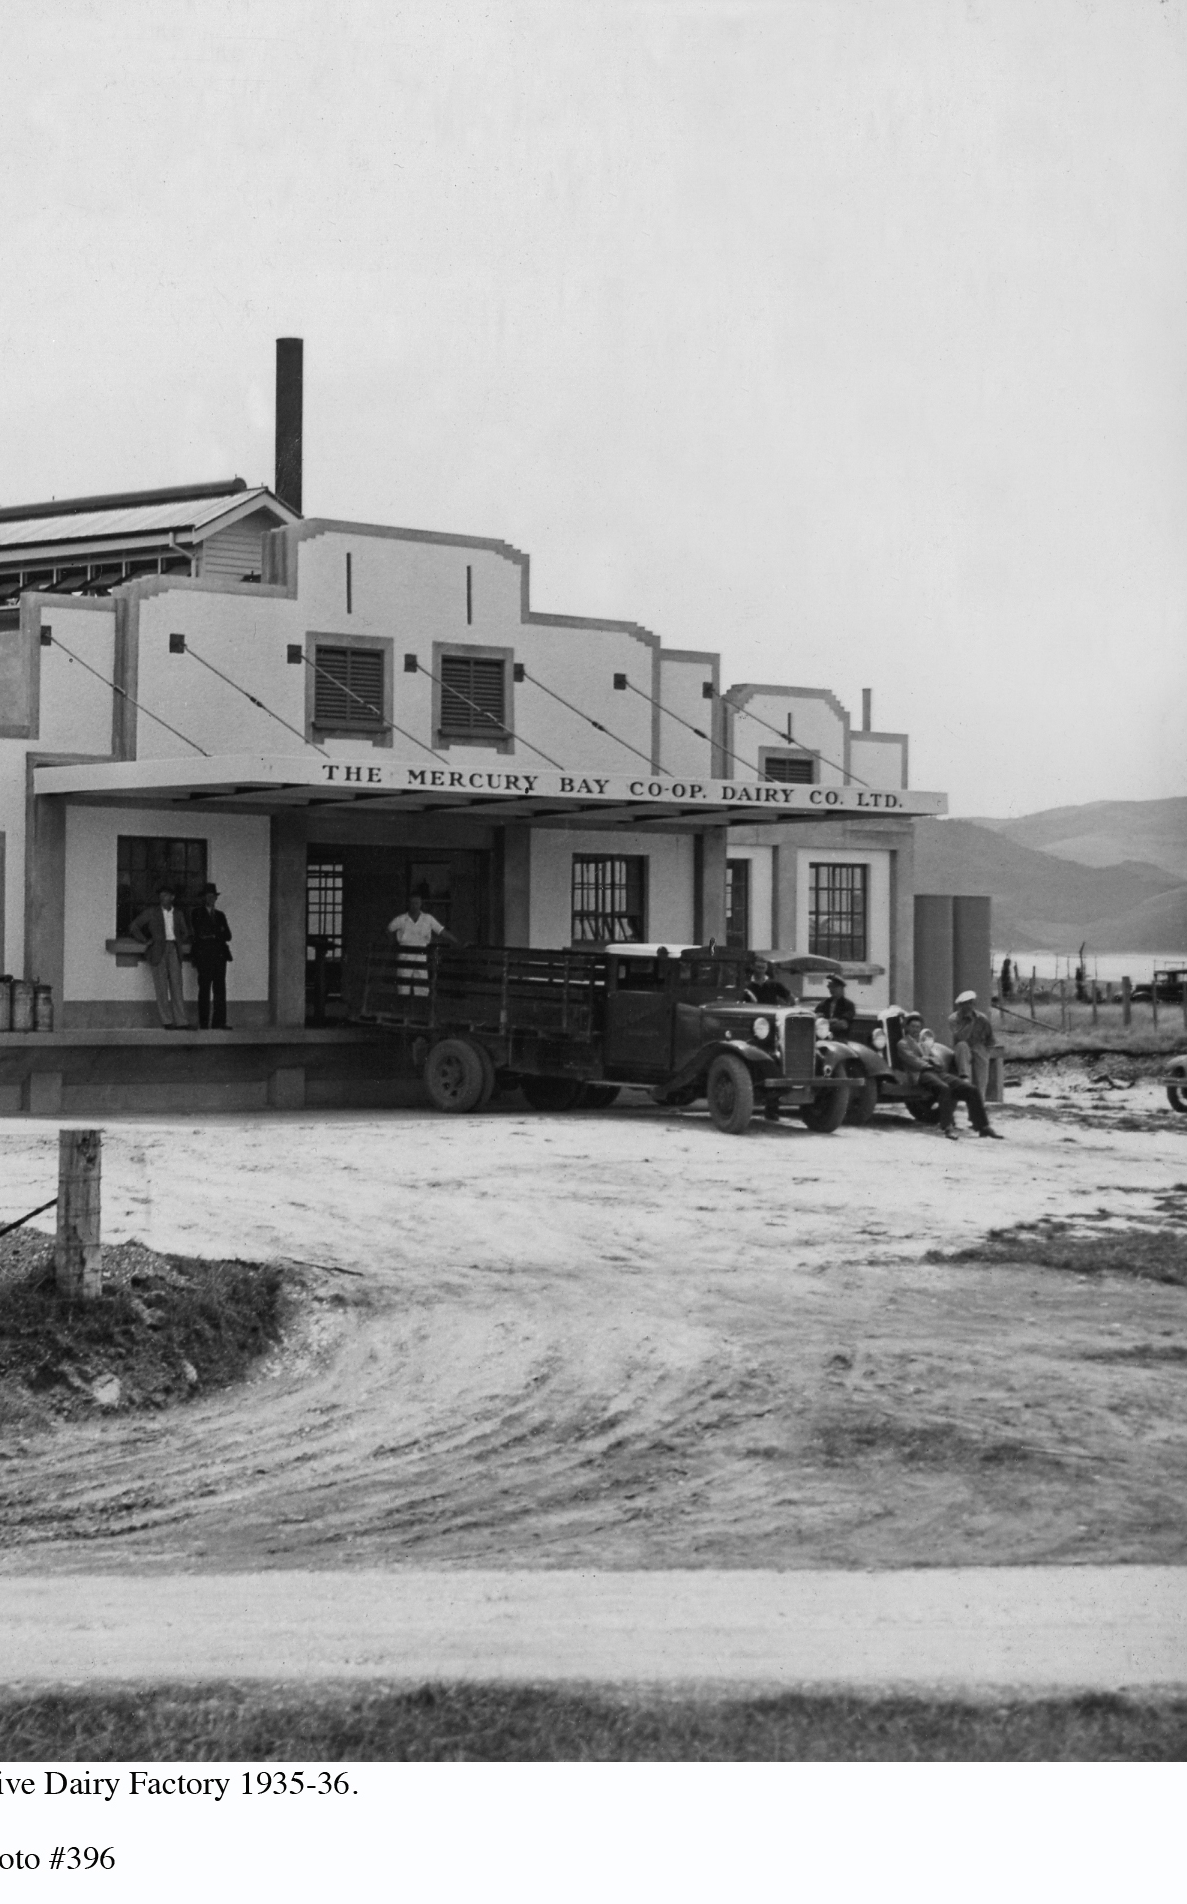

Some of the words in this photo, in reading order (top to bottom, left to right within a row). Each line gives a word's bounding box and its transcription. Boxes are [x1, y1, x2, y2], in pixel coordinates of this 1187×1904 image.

[322, 765, 382, 783] THE
[407, 769, 539, 791] MERCURY
[559, 777, 610, 795] BAY
[629, 781, 706, 799] CO-OP.
[721, 786, 795, 803] DAIRY
[809, 791, 844, 806] CO.
[857, 792, 903, 808] LTD.
